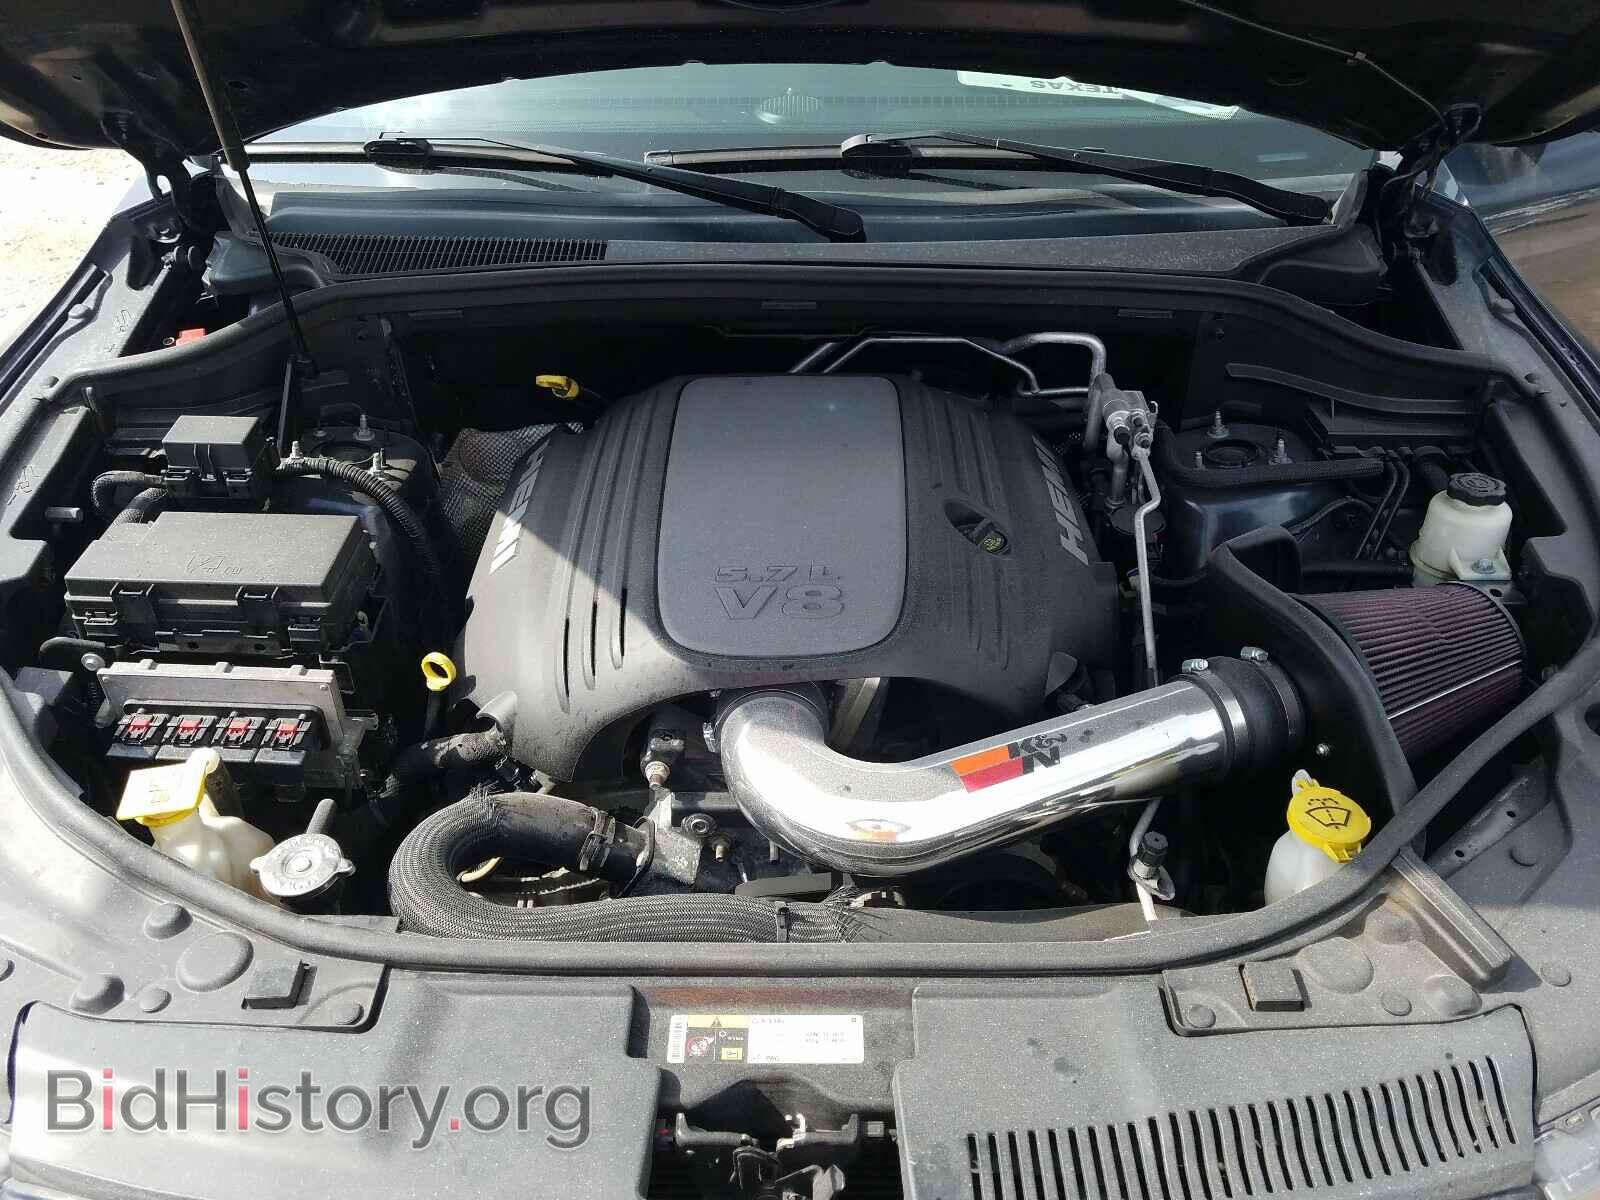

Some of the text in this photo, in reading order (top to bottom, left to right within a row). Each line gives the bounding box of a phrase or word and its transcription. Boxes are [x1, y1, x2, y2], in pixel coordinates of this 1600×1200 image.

[1031, 80, 1119, 94] TEXAS
[488, 438, 551, 576] HEMI
[1031, 433, 1089, 567] HEMI
[714, 585, 845, 620] V8
